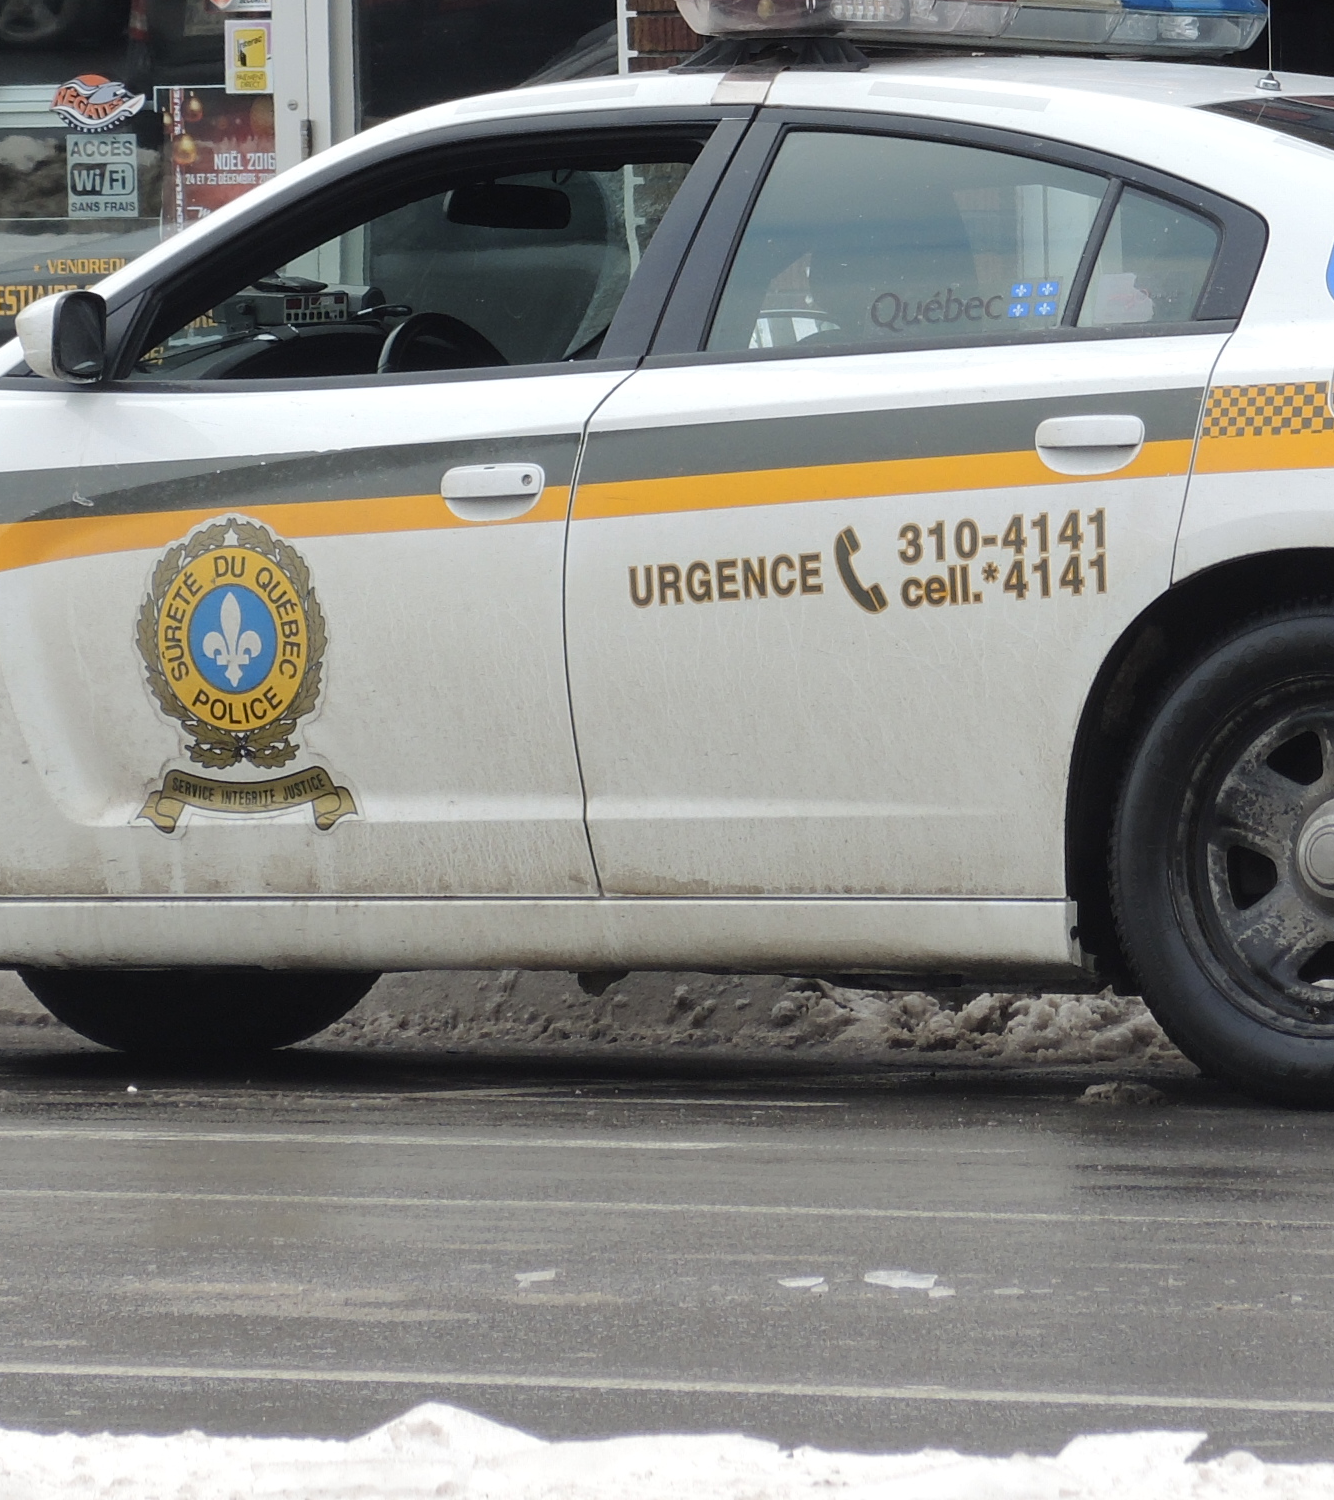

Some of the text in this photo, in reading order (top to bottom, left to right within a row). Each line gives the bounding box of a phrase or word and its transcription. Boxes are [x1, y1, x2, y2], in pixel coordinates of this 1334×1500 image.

[70, 136, 134, 157] ACCÈS
[214, 150, 277, 171] NOËL 2016
[185, 173, 195, 185] 24
[197, 173, 206, 184] ET
[218, 171, 256, 184] DÉCEMBRE
[70, 201, 136, 212] SANS FRAIS
[870, 286, 1003, 333] Québec
[897, 507, 1108, 565] 310-4141
[627, 551, 825, 609] URGENCE
[161, 555, 302, 682] SÛRETÉ DU QUÉBEC
[191, 686, 284, 725] POLICE
[171, 776, 216, 802] SERVICE
[282, 773, 326, 801] JUSTICE
